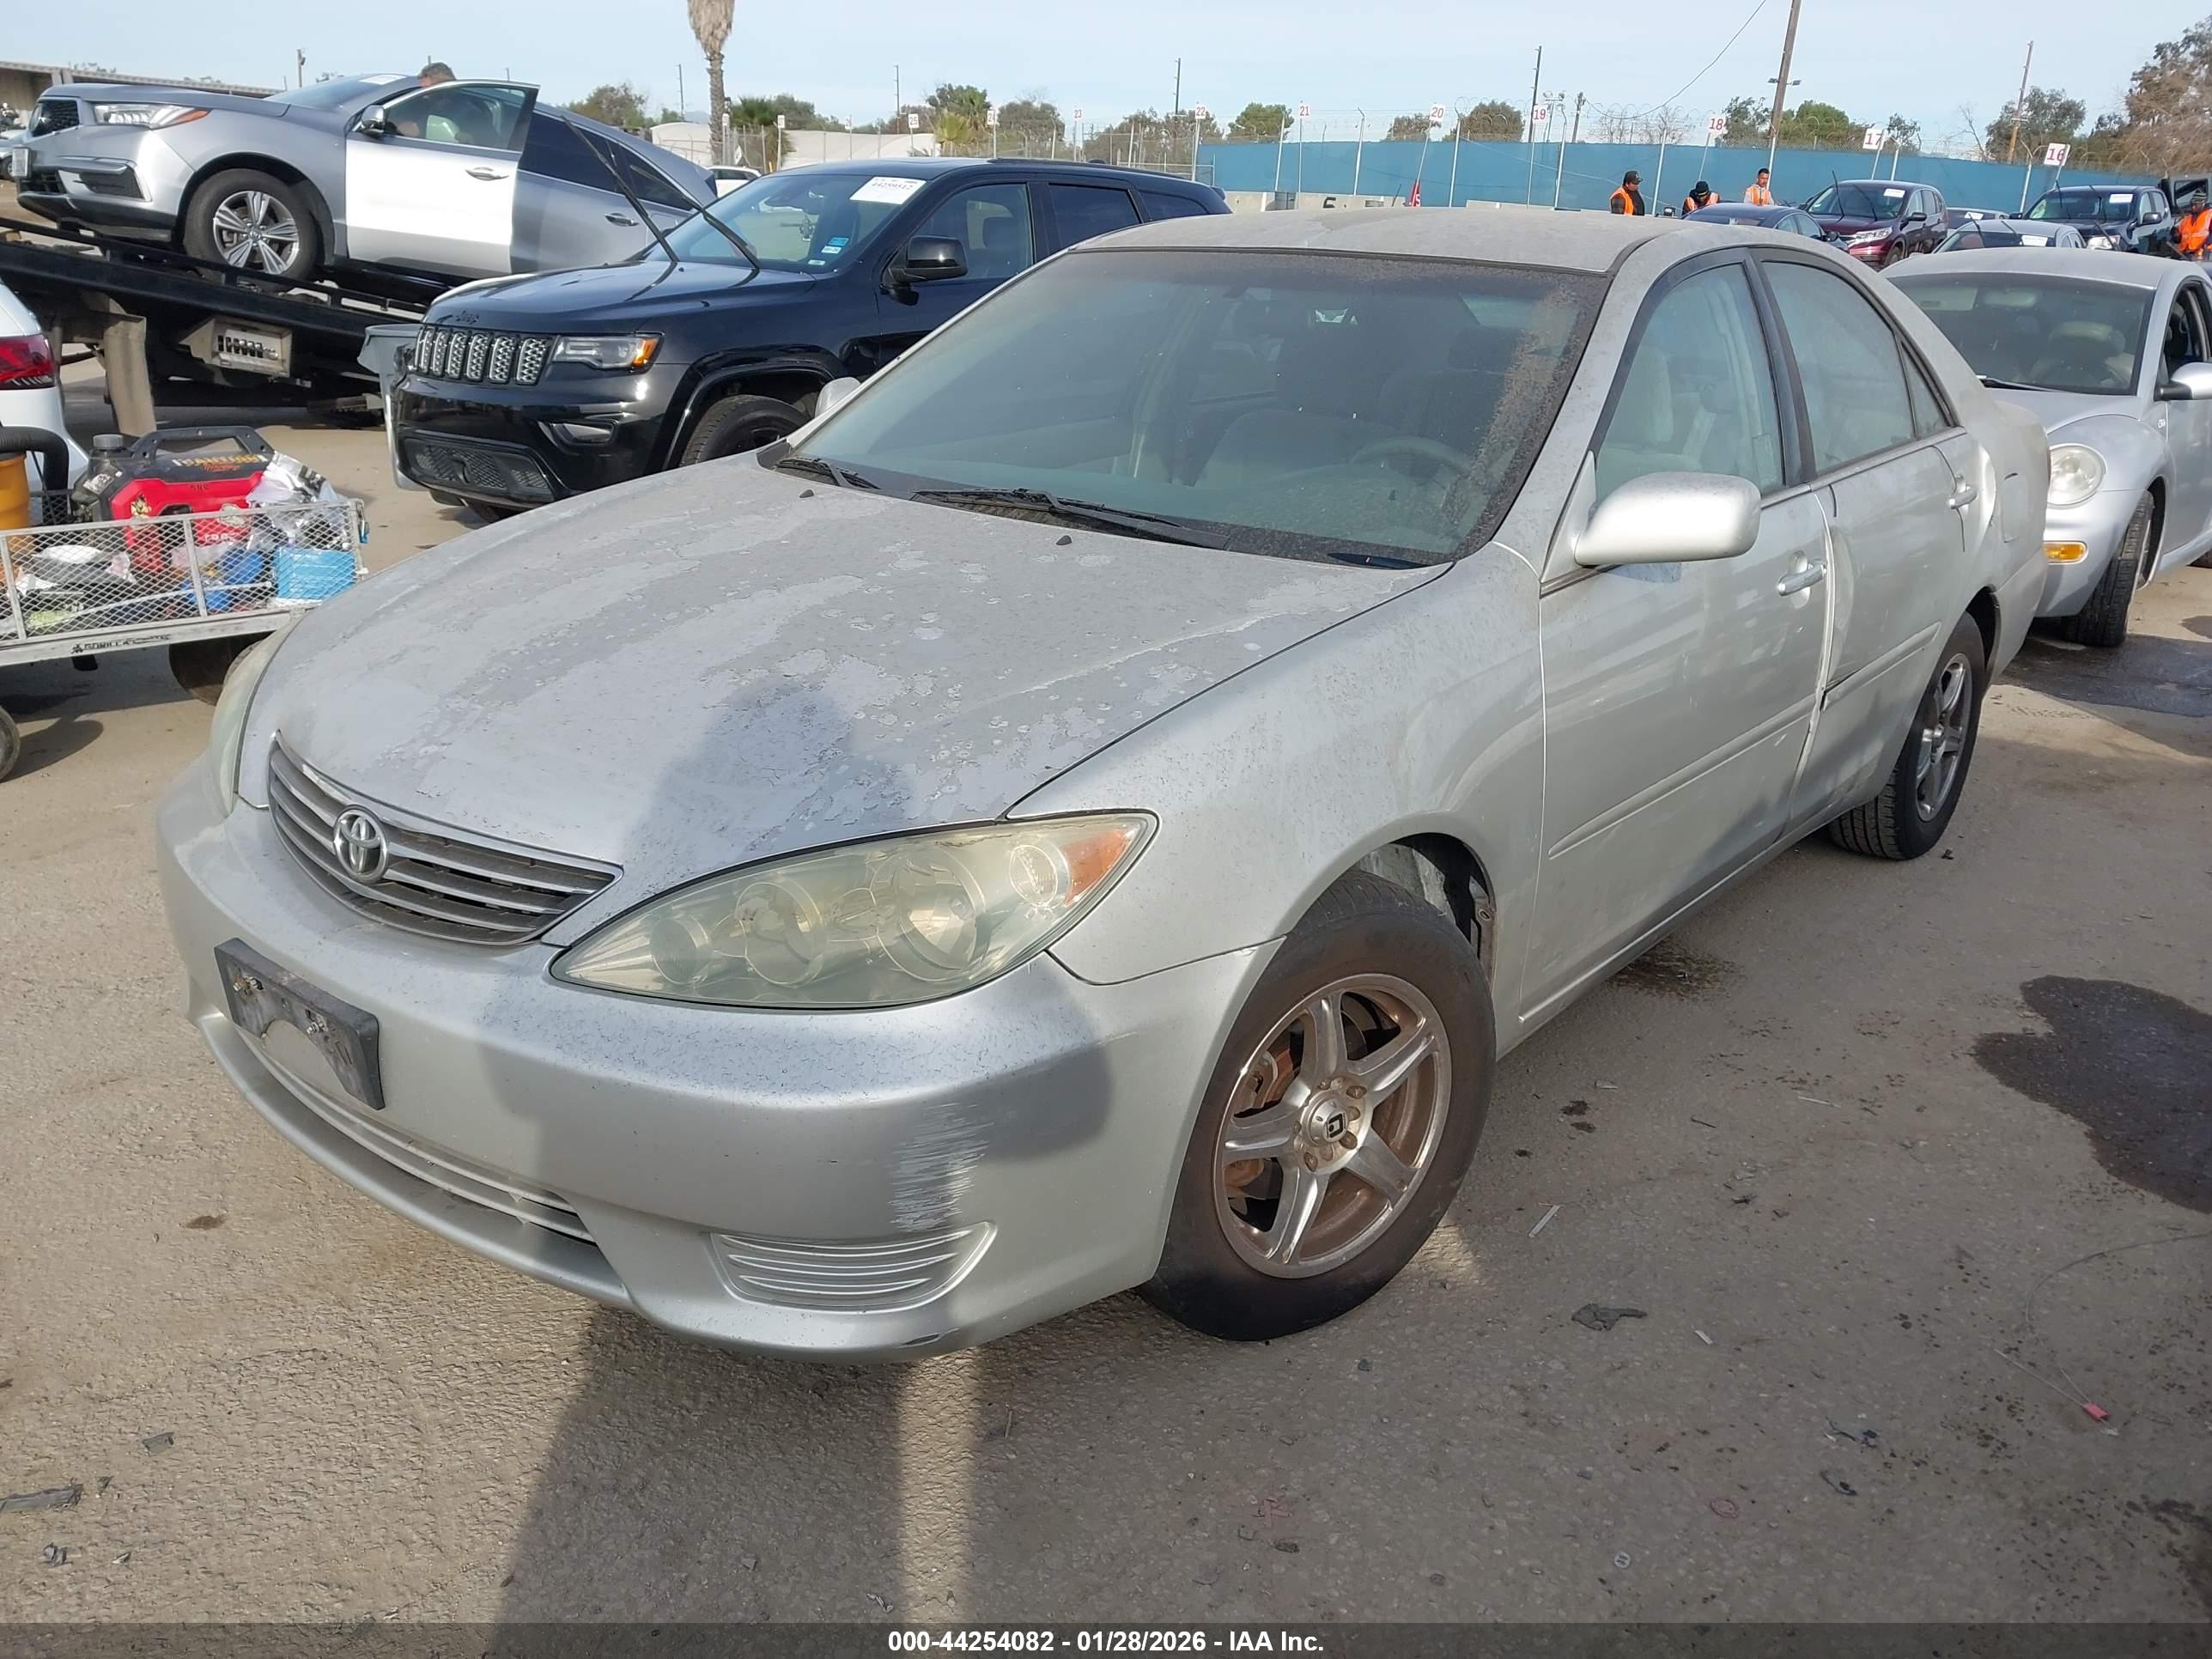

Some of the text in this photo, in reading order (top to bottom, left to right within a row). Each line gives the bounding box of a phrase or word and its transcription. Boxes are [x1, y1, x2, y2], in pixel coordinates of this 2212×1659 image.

[1074, 109, 1082, 118] 23
[1195, 106, 1206, 117] 22
[1299, 106, 1310, 116] 21
[1431, 106, 1443, 118] 20
[1534, 109, 1547, 120] 19
[909, 117, 918, 125] 25
[1710, 118, 1723, 131] 18
[1865, 133, 1882, 146] 17
[2046, 148, 2065, 161] 16
